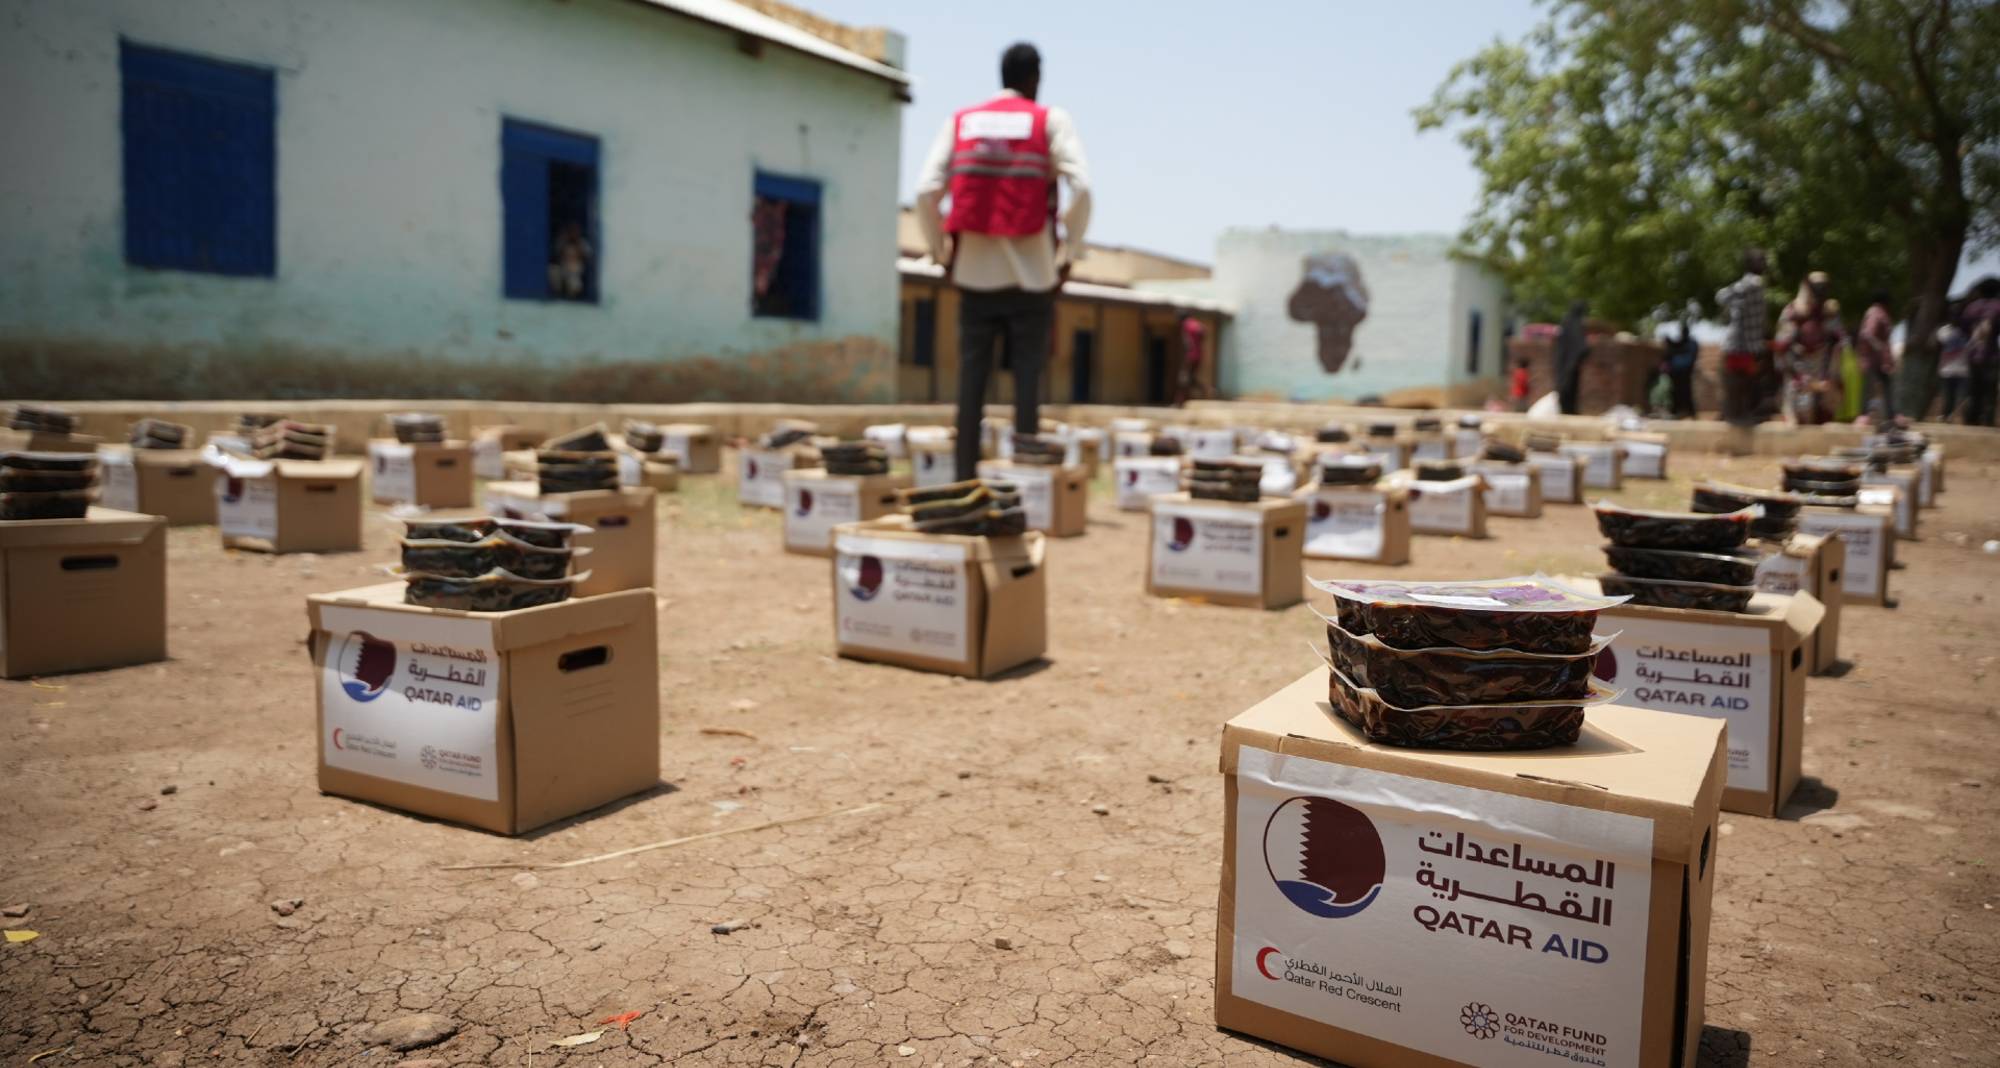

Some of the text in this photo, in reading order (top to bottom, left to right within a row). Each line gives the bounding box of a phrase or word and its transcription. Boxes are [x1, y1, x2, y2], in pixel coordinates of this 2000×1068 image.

[1636, 645, 1751, 668] المساعدات
[1636, 662, 1750, 689] القطرية
[404, 686, 482, 711] QATAR AID
[1634, 687, 1749, 711] QATAR AID
[1418, 831, 1615, 889] المساعدات
[1416, 860, 1613, 926] القطرية
[1413, 905, 1609, 964] QATAR AID
[1284, 958, 1402, 997] الهلال الأحمر القطري
[1284, 969, 1401, 1013] Qatar Red Crescent
[1504, 1025, 1606, 1056] FOR DEVELOPMENT
[1505, 1012, 1607, 1046] QATAR FUND
